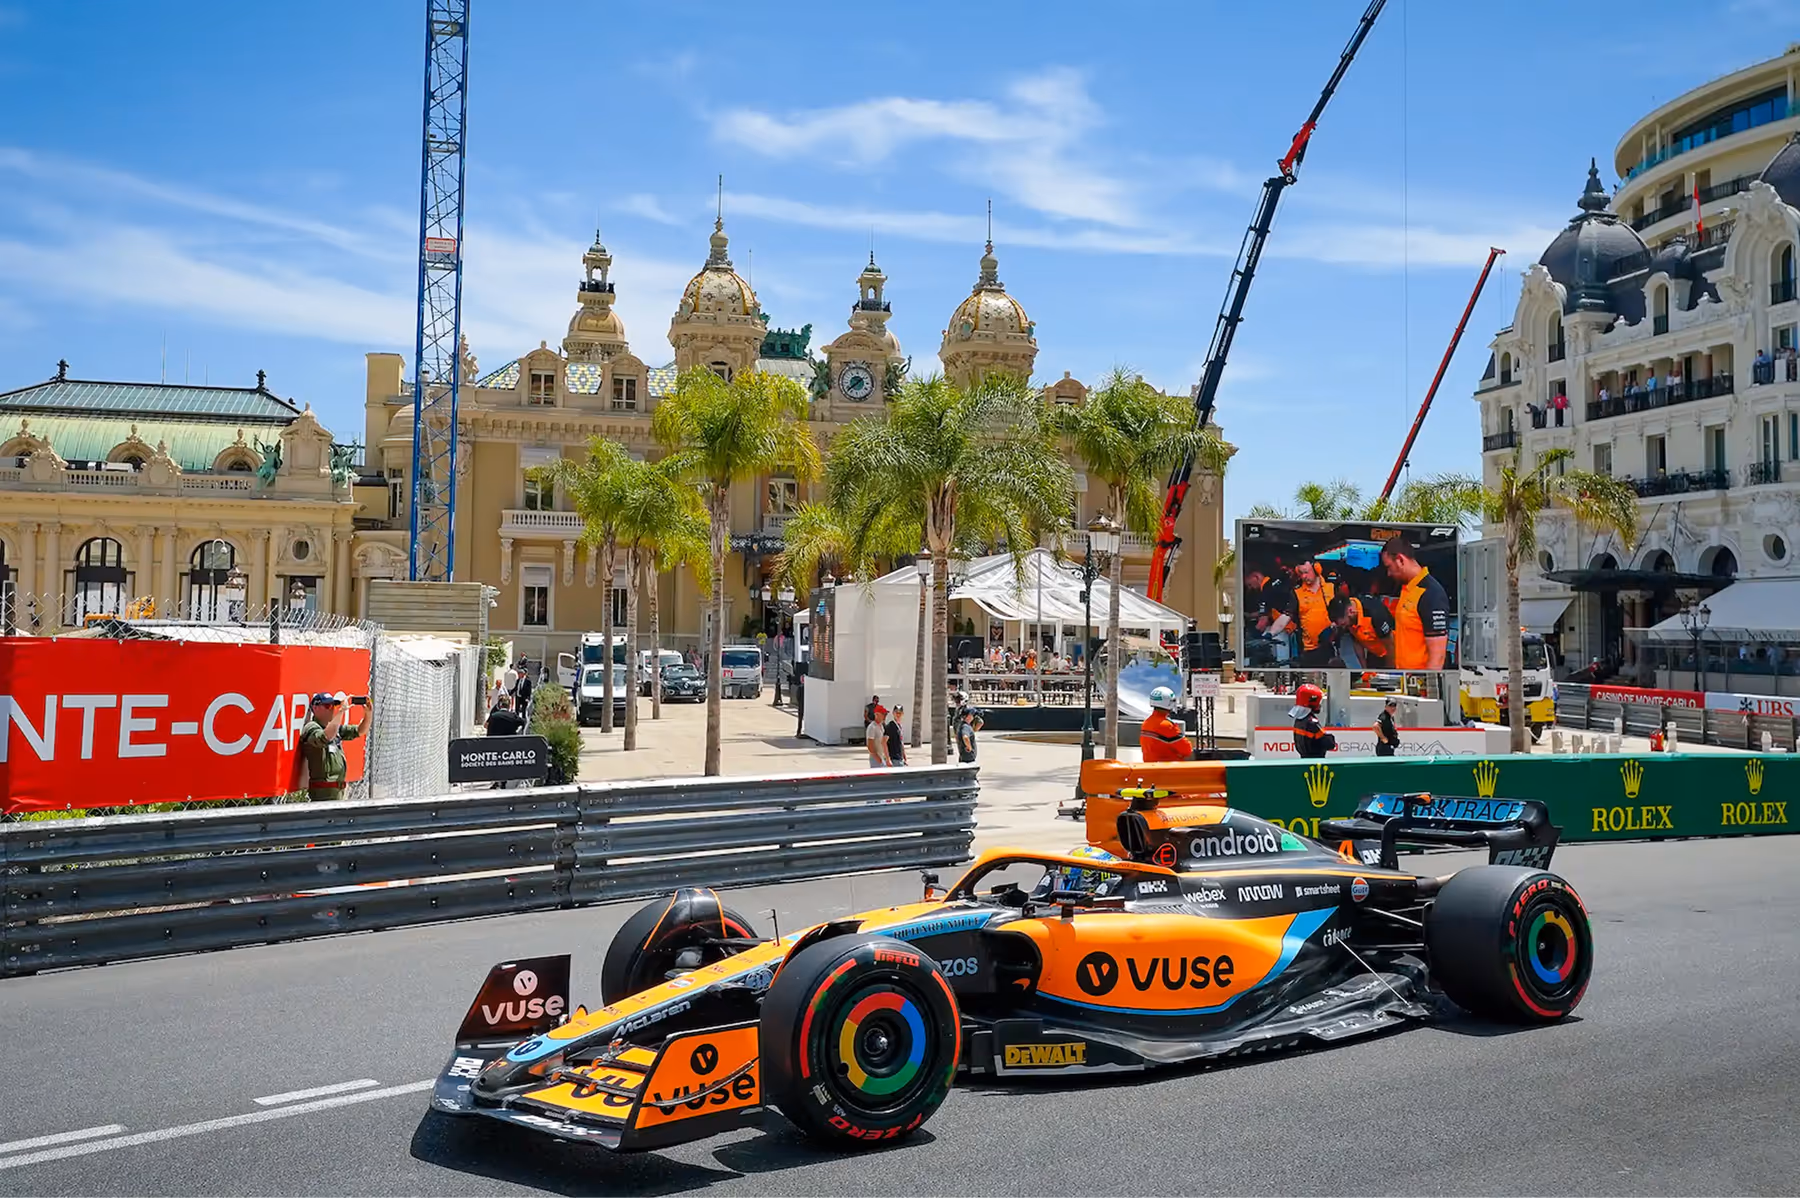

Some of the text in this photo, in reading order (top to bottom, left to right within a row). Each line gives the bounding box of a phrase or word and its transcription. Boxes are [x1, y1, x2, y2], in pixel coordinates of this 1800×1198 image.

[1757, 700, 1793, 716] UBS
[1339, 742, 1377, 752] GRAN
[1592, 805, 1674, 832] ROLEX
[1721, 801, 1788, 826] ROLEX
[1190, 828, 1278, 858] android
[1137, 879, 1168, 894] OKX
[1183, 887, 1226, 904] webex
[1304, 883, 1341, 896] smartsheet
[1352, 885, 1369, 894] Gulf
[1513, 878, 1550, 920] ZERO
[893, 917, 980, 939] RICHARD MILLE
[874, 949, 920, 967] PIRELLI
[612, 1000, 691, 1039] McLaren
[828, 1115, 902, 1140] ZERO
